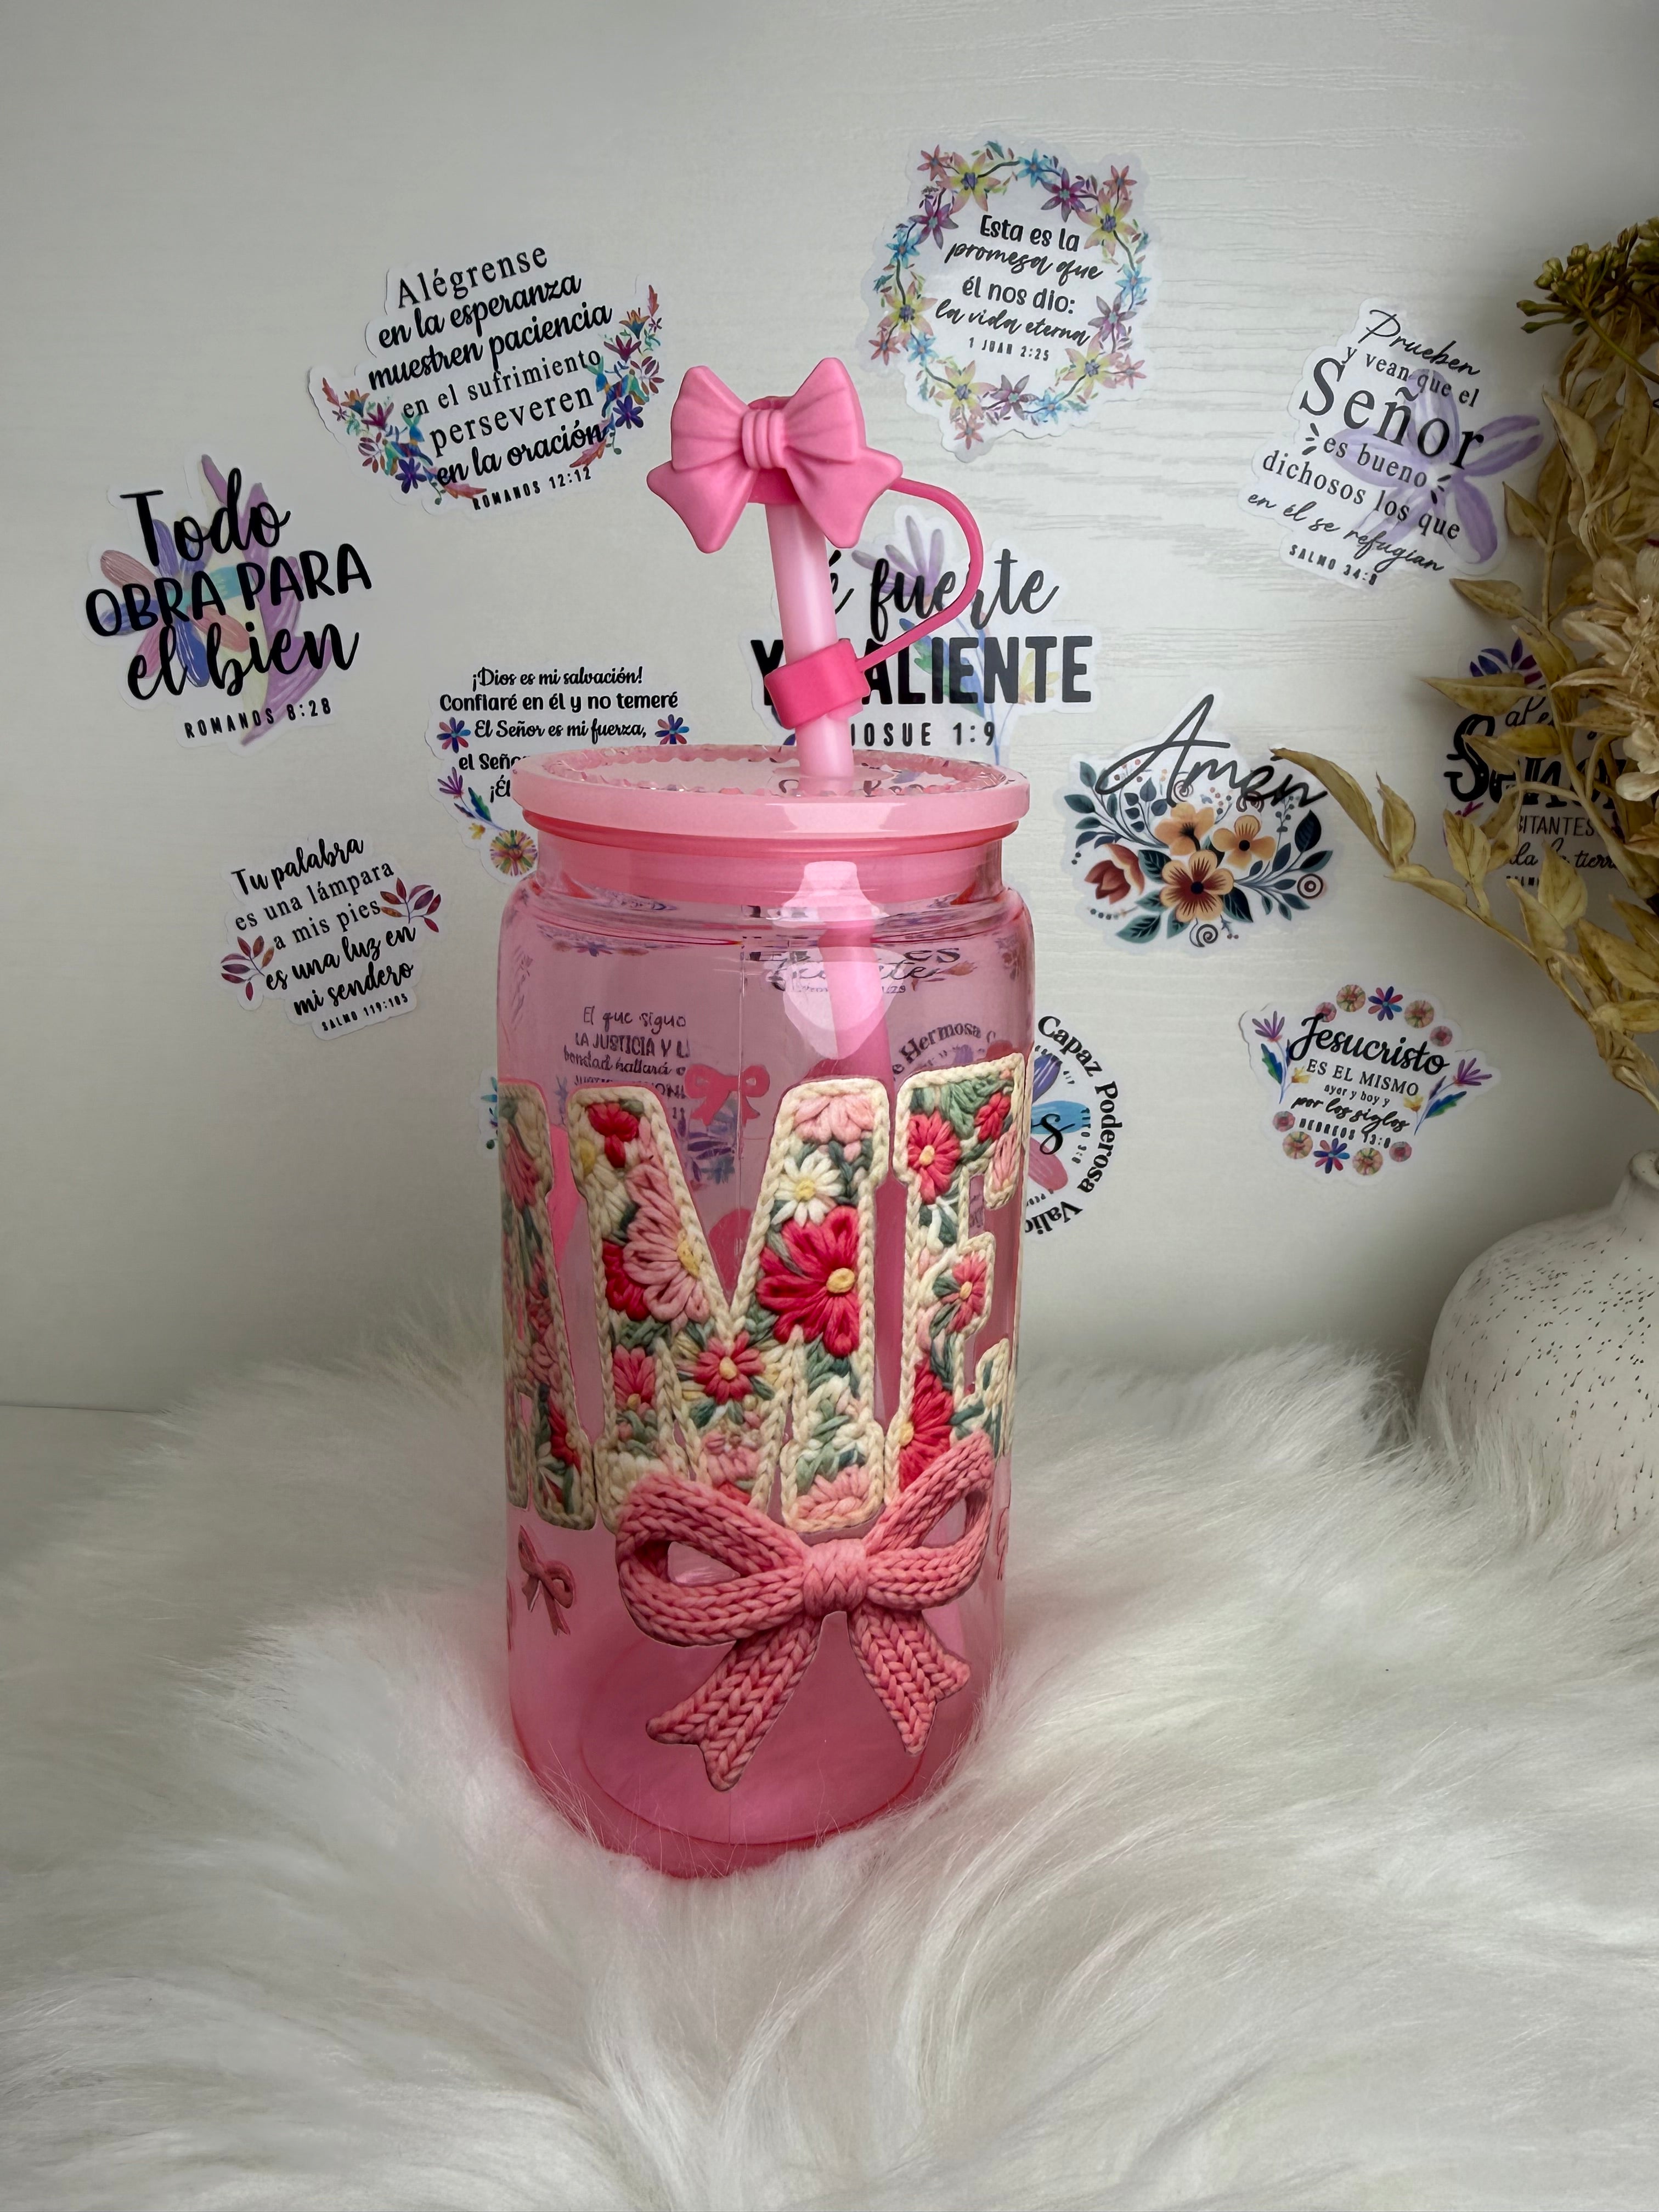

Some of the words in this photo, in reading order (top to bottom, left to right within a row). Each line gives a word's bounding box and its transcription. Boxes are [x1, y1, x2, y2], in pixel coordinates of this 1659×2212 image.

[980, 215, 1024, 242] Esta
[1030, 226, 1053, 245] es
[1059, 228, 1080, 252] la
[398, 247, 548, 308] Alégrense
[944, 242, 1053, 275] promesa
[1056, 260, 1103, 286] que
[379, 322, 411, 348] en
[414, 308, 445, 338] la
[450, 275, 582, 340] esperanza
[962, 276, 981, 298] él
[988, 283, 1026, 305] nos
[1032, 289, 1075, 314] dio:
[369, 343, 483, 390] muestren
[489, 302, 613, 371] paciencia
[935, 298, 966, 323] la
[968, 308, 1023, 335] vida
[1025, 318, 1092, 347] eterna
[1357, 309, 1481, 375] Prueben
[969, 337, 974, 348] 1
[981, 338, 1013, 355] JUAN
[1021, 346, 1049, 362] 2:25
[403, 398, 430, 418] en
[438, 384, 459, 409] el
[469, 349, 601, 400] sufrimiento
[1342, 347, 1357, 365] y
[1366, 353, 1409, 382] vean
[1417, 372, 1452, 398] que
[1458, 388, 1480, 407] el
[430, 387, 594, 458] perseveren
[1299, 358, 1485, 469] Señor
[437, 461, 469, 485] en
[471, 447, 502, 476] la
[507, 420, 607, 466] oración
[1323, 437, 1348, 458] es
[1357, 443, 1427, 487] bueno
[472, 480, 541, 510] ROMANOS
[548, 466, 592, 490] 12:12
[1262, 450, 1366, 505] dichosos
[1373, 490, 1410, 523] los
[1419, 513, 1460, 540] que
[120, 467, 292, 567] Todo
[1248, 492, 1277, 509] en
[1283, 501, 1317, 522] él
[1308, 516, 1341, 532] se
[1343, 527, 1445, 573] refugian
[1289, 544, 1336, 570] SALMO
[86, 570, 227, 637] OBRA
[236, 543, 373, 611] PARA
[127, 623, 188, 700] el
[206, 621, 360, 697] bien
[472, 667, 517, 692] ¡Dios
[520, 672, 536, 686] es
[539, 668, 561, 685] mi
[563, 666, 644, 685] salvación!
[860, 636, 1092, 705] ALIENTE
[184, 707, 275, 739] ROMANOS
[286, 697, 331, 722] 8:28
[439, 693, 518, 712] Confiaré
[522, 696, 544, 710] en
[549, 692, 566, 710] él
[570, 696, 582, 713] y
[588, 695, 612, 709] no
[617, 691, 679, 708] temeré
[475, 719, 493, 738] El
[495, 719, 546, 738] Señor
[548, 722, 563, 737] es
[567, 720, 589, 737] mi
[590, 718, 647, 745] fuerza,
[953, 721, 995, 746] 1:9
[459, 753, 475, 770] el
[231, 868, 269, 895] Tu
[271, 838, 364, 890] palabra
[235, 912, 258, 930] es
[263, 896, 303, 921] una
[306, 862, 394, 905] lámpara
[274, 936, 286, 950] a
[292, 916, 330, 944] mis
[336, 900, 381, 932] pies
[266, 970, 288, 991] es
[291, 953, 340, 980] una
[341, 936, 381, 962] luz
[386, 926, 416, 947] en
[294, 989, 325, 1016] mi
[327, 961, 414, 1007] sendero
[321, 1011, 358, 1031] SALMO
[363, 992, 409, 1016] 119:105
[583, 1006, 595, 1026] El
[602, 1011, 633, 1032] que
[899, 1023, 982, 1064] Hermosa
[1289, 1012, 1450, 1075] Jesucristo
[593, 1033, 656, 1057] JUSTICIA
[1306, 1058, 1328, 1075] ES
[1332, 1065, 1353, 1082] EL
[1359, 1071, 1419, 1096] MISMO
[1324, 1084, 1347, 1096] ayer
[1350, 1091, 1357, 1101] y
[1361, 1091, 1380, 1105] hoy
[1382, 1098, 1390, 1108] y
[1038, 1015, 1103, 1077] Capaz
[1077, 1081, 1123, 1194] Poderosa
[1290, 1097, 1324, 1109] por
[1325, 1097, 1352, 1119] los
[1348, 1108, 1410, 1134] siglos
